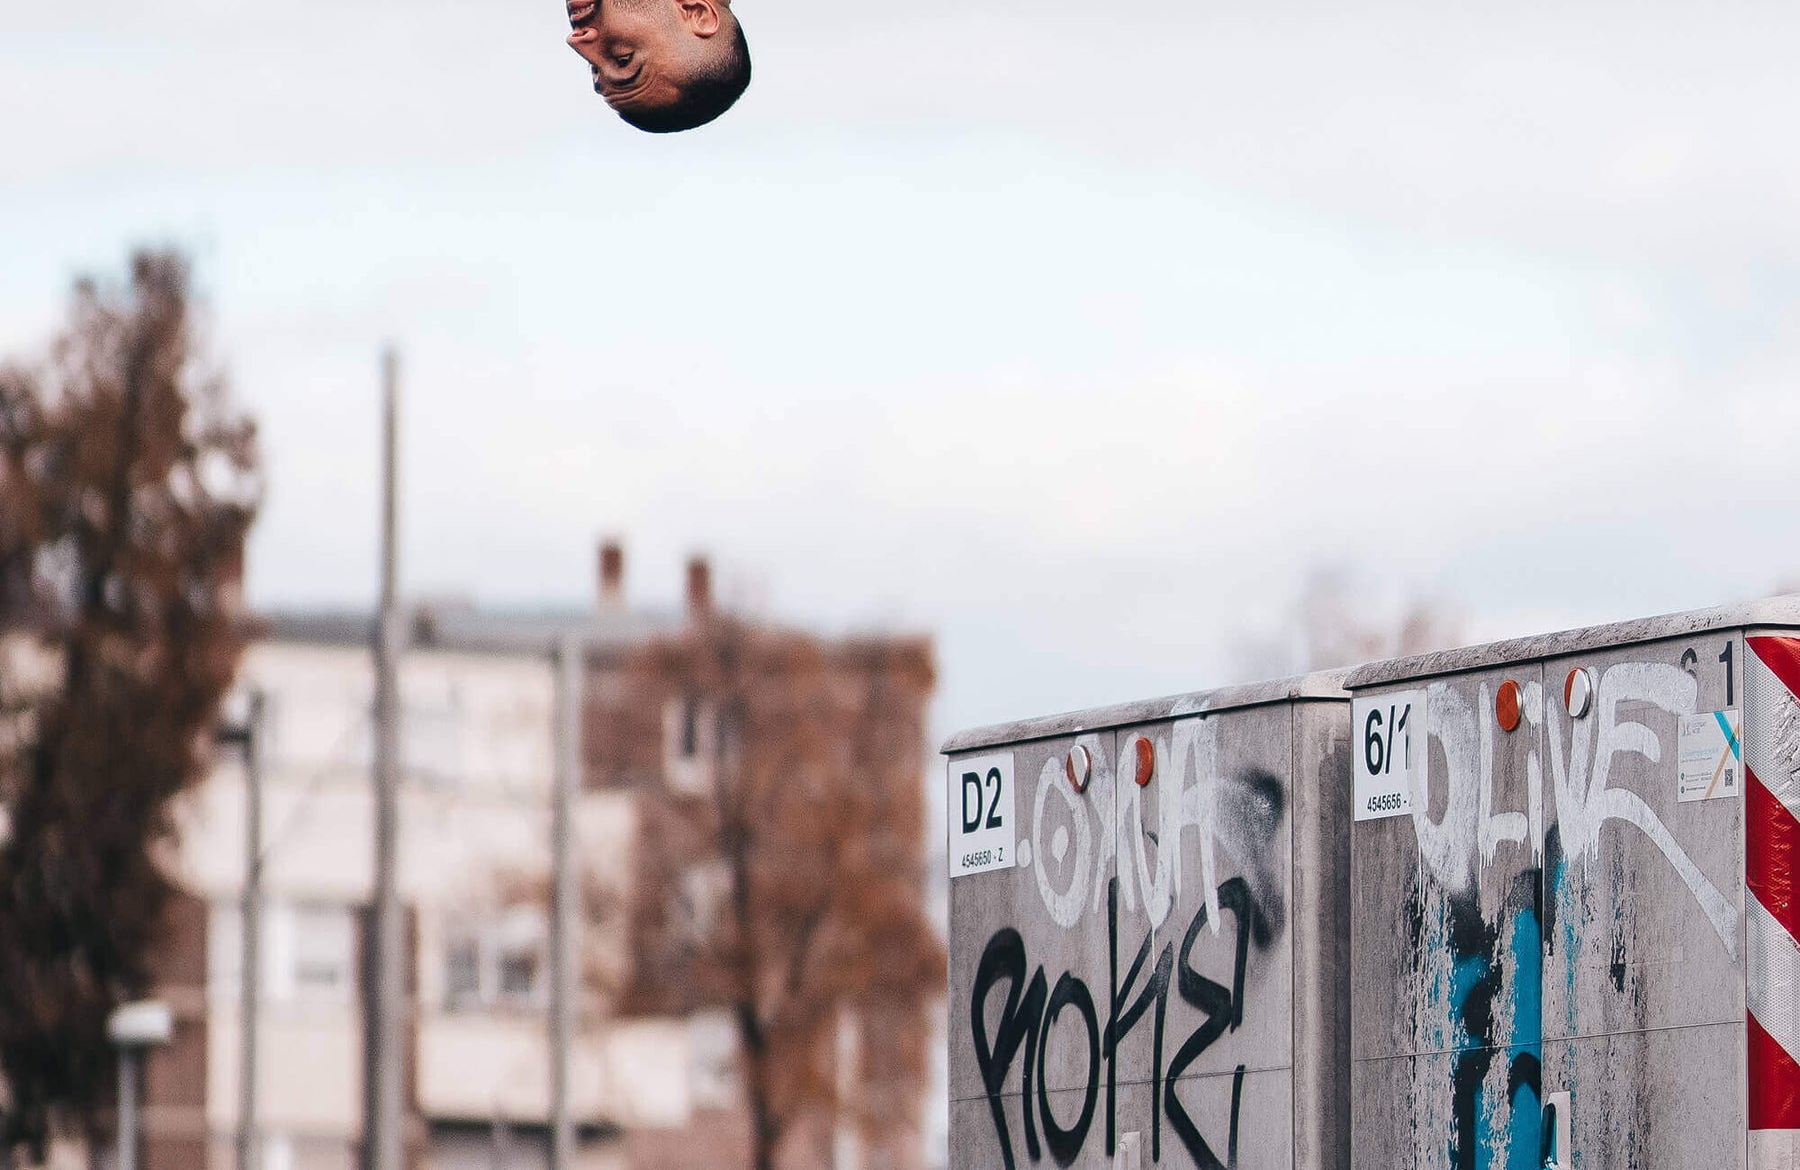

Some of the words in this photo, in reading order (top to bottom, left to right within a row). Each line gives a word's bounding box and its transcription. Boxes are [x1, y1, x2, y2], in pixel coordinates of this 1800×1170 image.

[1719, 641, 1734, 706] 1
[1364, 703, 1411, 776] 6/1
[961, 766, 1003, 835] D2
[1367, 793, 1402, 812] 4545656
[961, 849, 992, 869] 4545650
